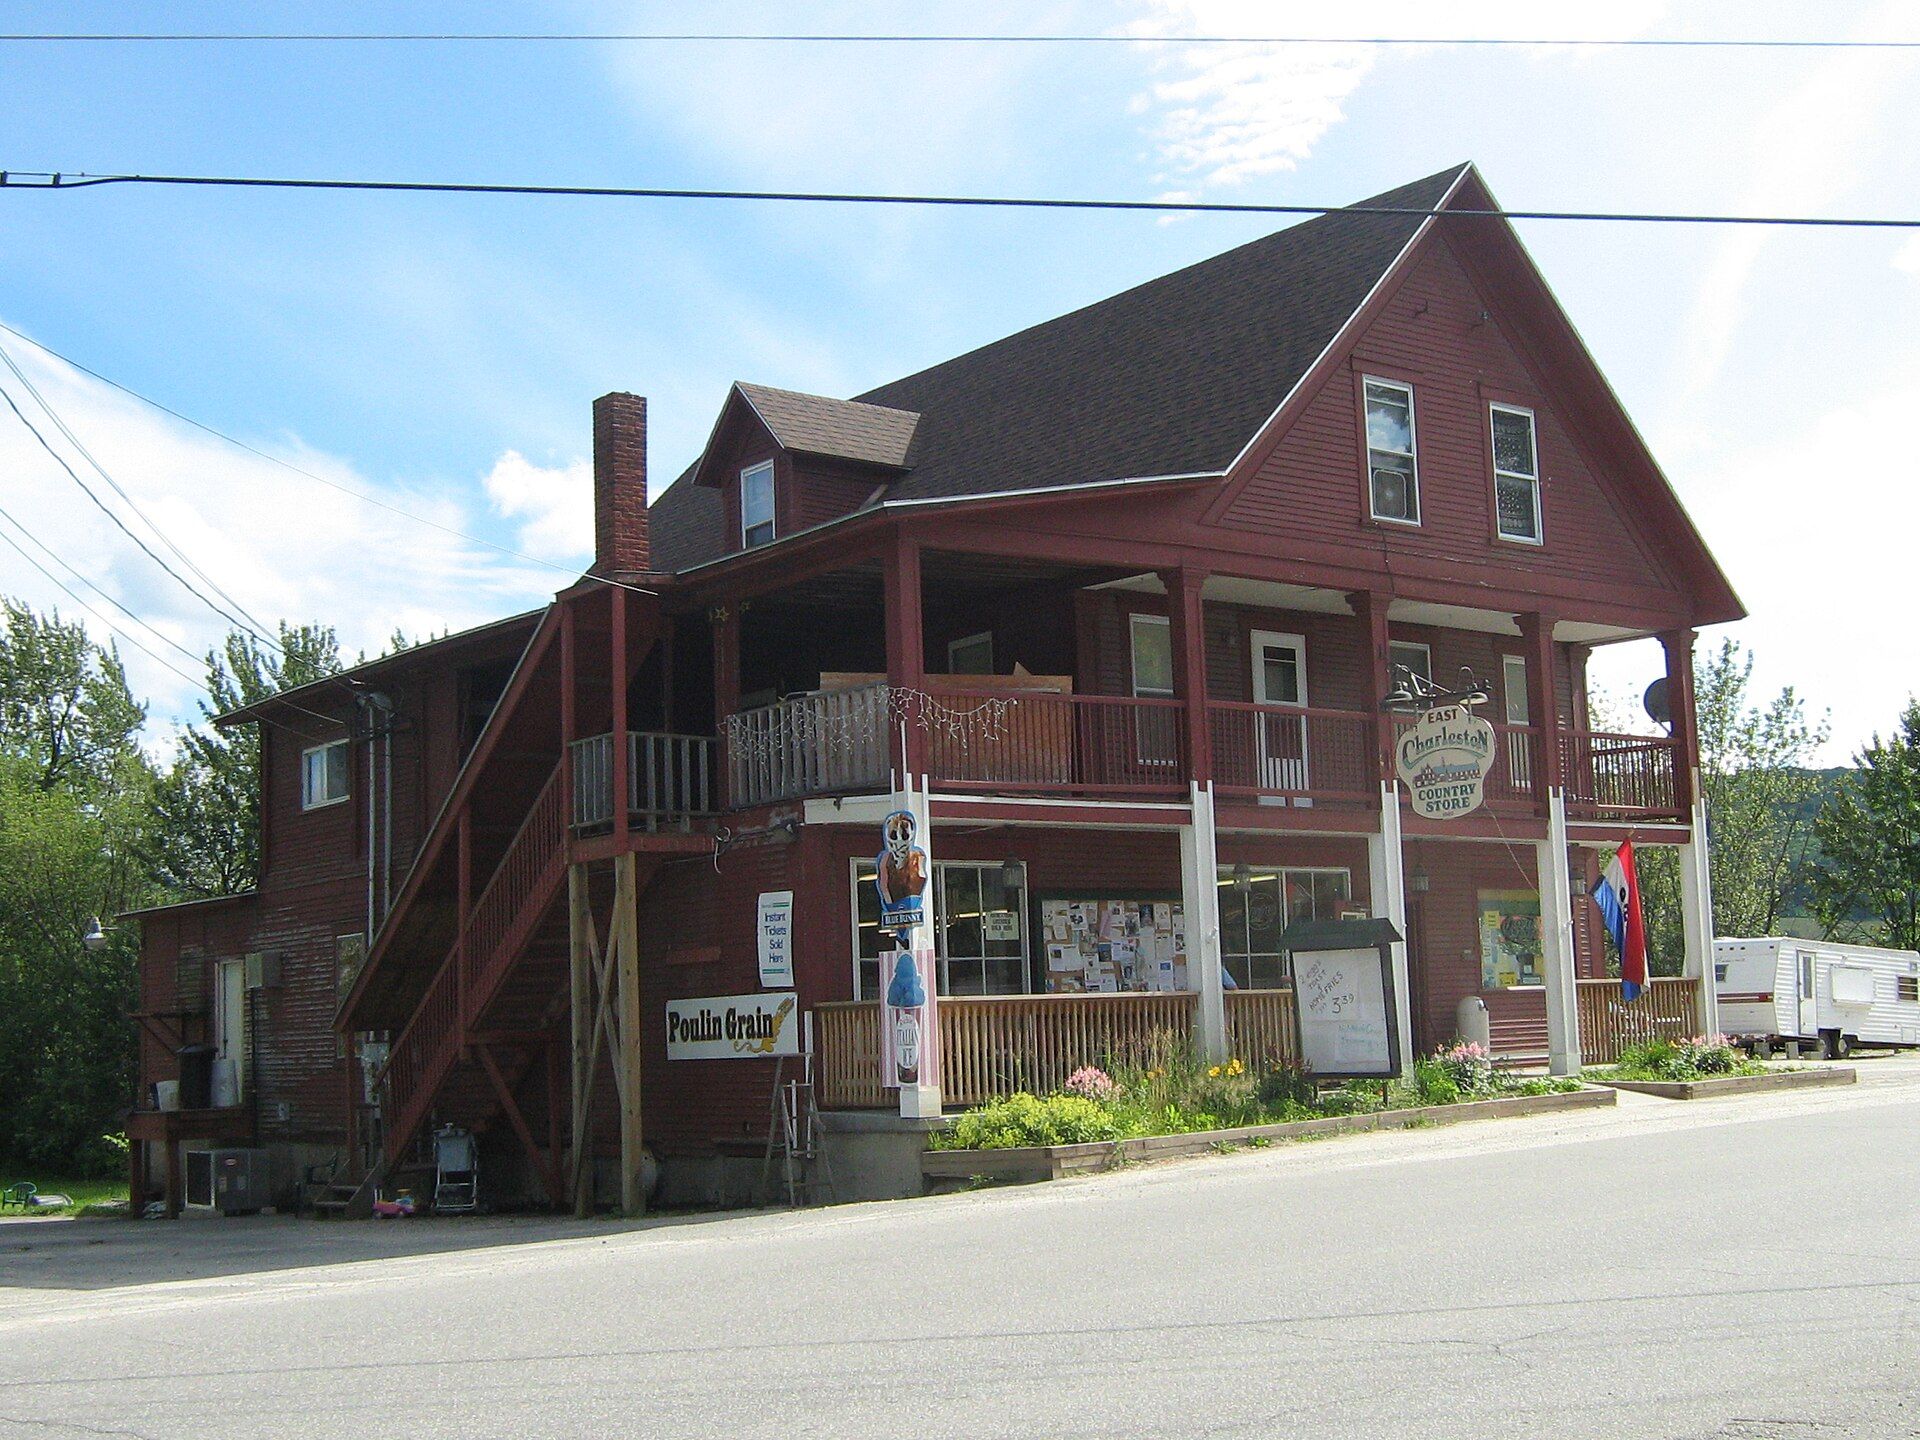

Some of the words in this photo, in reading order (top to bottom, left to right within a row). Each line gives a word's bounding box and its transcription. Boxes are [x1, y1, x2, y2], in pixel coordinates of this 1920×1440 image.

[1428, 709, 1458, 724] EAST
[1418, 783, 1476, 801] COUNTRY
[1425, 797, 1470, 812] STORE
[765, 912, 786, 922] Instant
[885, 914, 898, 925] BLUE
[764, 925, 787, 936] Tickets
[769, 939, 783, 950] Sold
[769, 952, 784, 963] Here
[668, 1009, 722, 1042] Poulin
[725, 1006, 773, 1040] Grain
